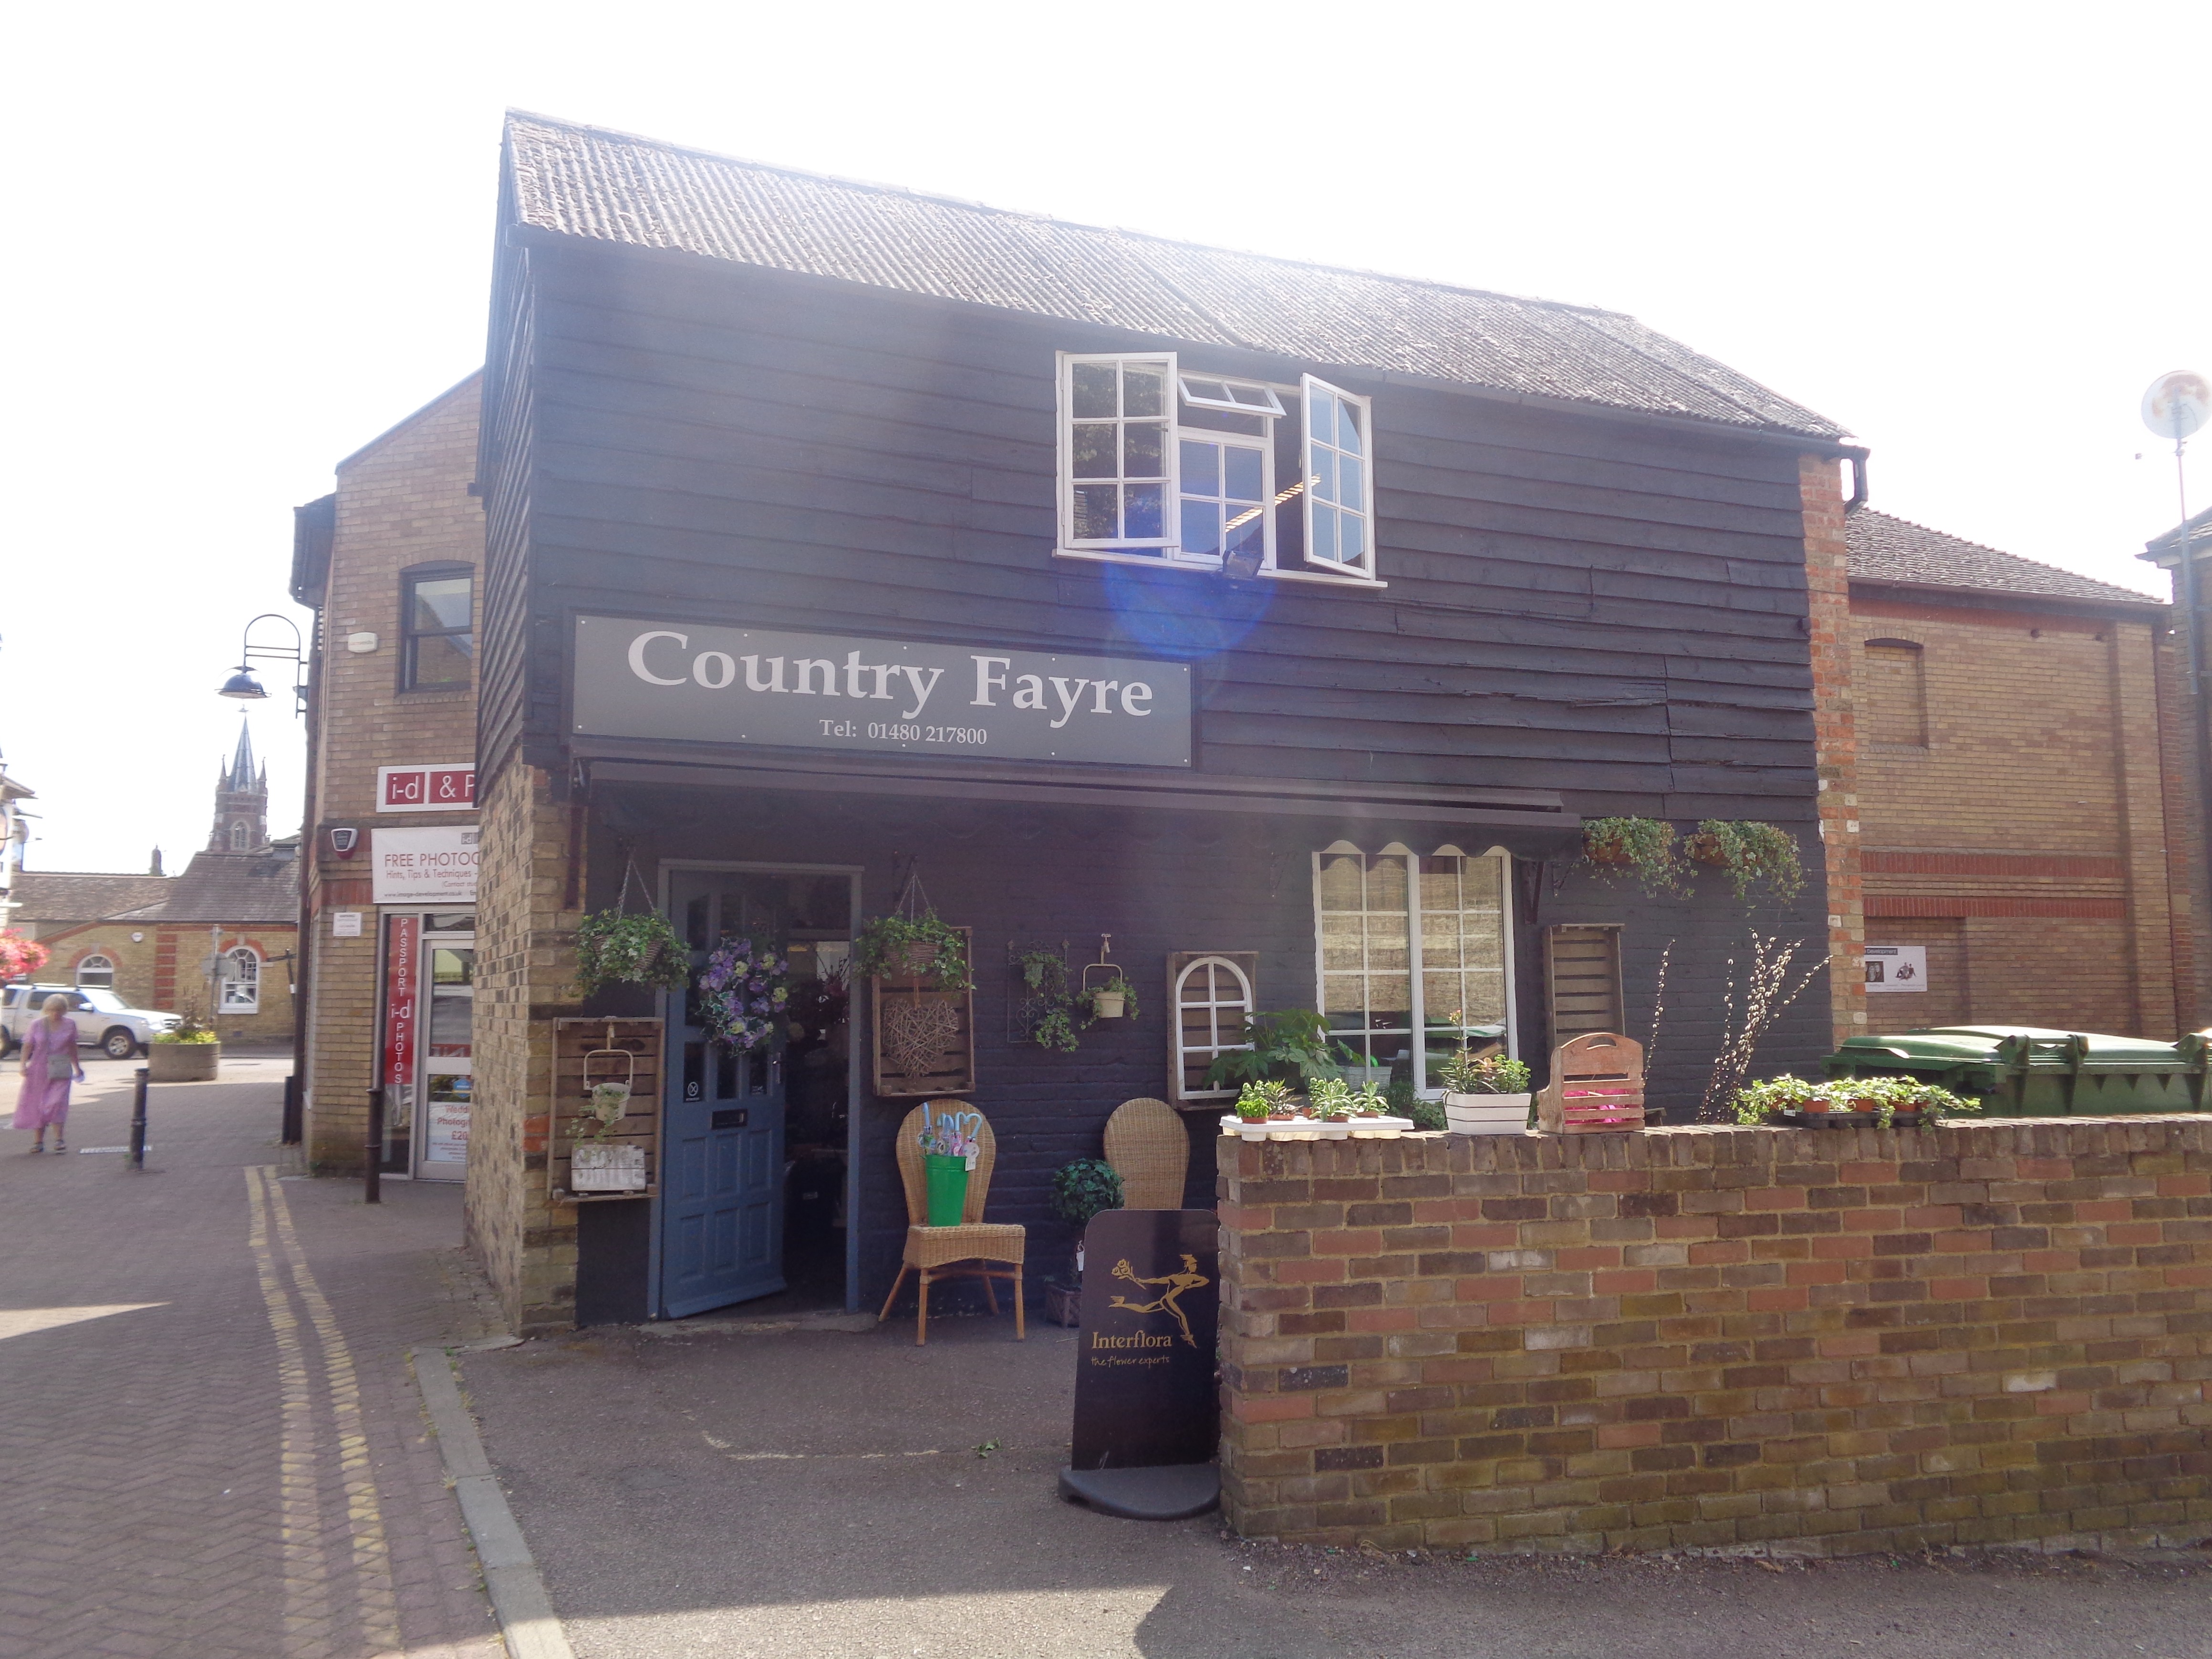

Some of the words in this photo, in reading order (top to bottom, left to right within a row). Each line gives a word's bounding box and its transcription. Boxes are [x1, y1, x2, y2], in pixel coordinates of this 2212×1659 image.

[628, 631, 945, 719] Country
[970, 655, 1153, 728] Fayre
[819, 719, 857, 737] Tel:
[867, 722, 920, 741] 01480
[925, 726, 987, 745] 217800
[392, 776, 419, 799] i-d
[439, 775, 456, 798] &
[384, 854, 414, 867] FREE
[386, 870, 405, 880] Hints,
[407, 870, 421, 881] Tips
[424, 869, 429, 878] &
[433, 869, 471, 880] Techniques
[399, 918, 408, 997] PASSPORT
[391, 999, 411, 1019] i-d
[395, 1022, 405, 1084] PHOTOS
[1091, 1330, 1172, 1349] Interflora
[1091, 1356, 1107, 1366] the
[1107, 1356, 1137, 1368] flower
[1138, 1355, 1170, 1369] experts
